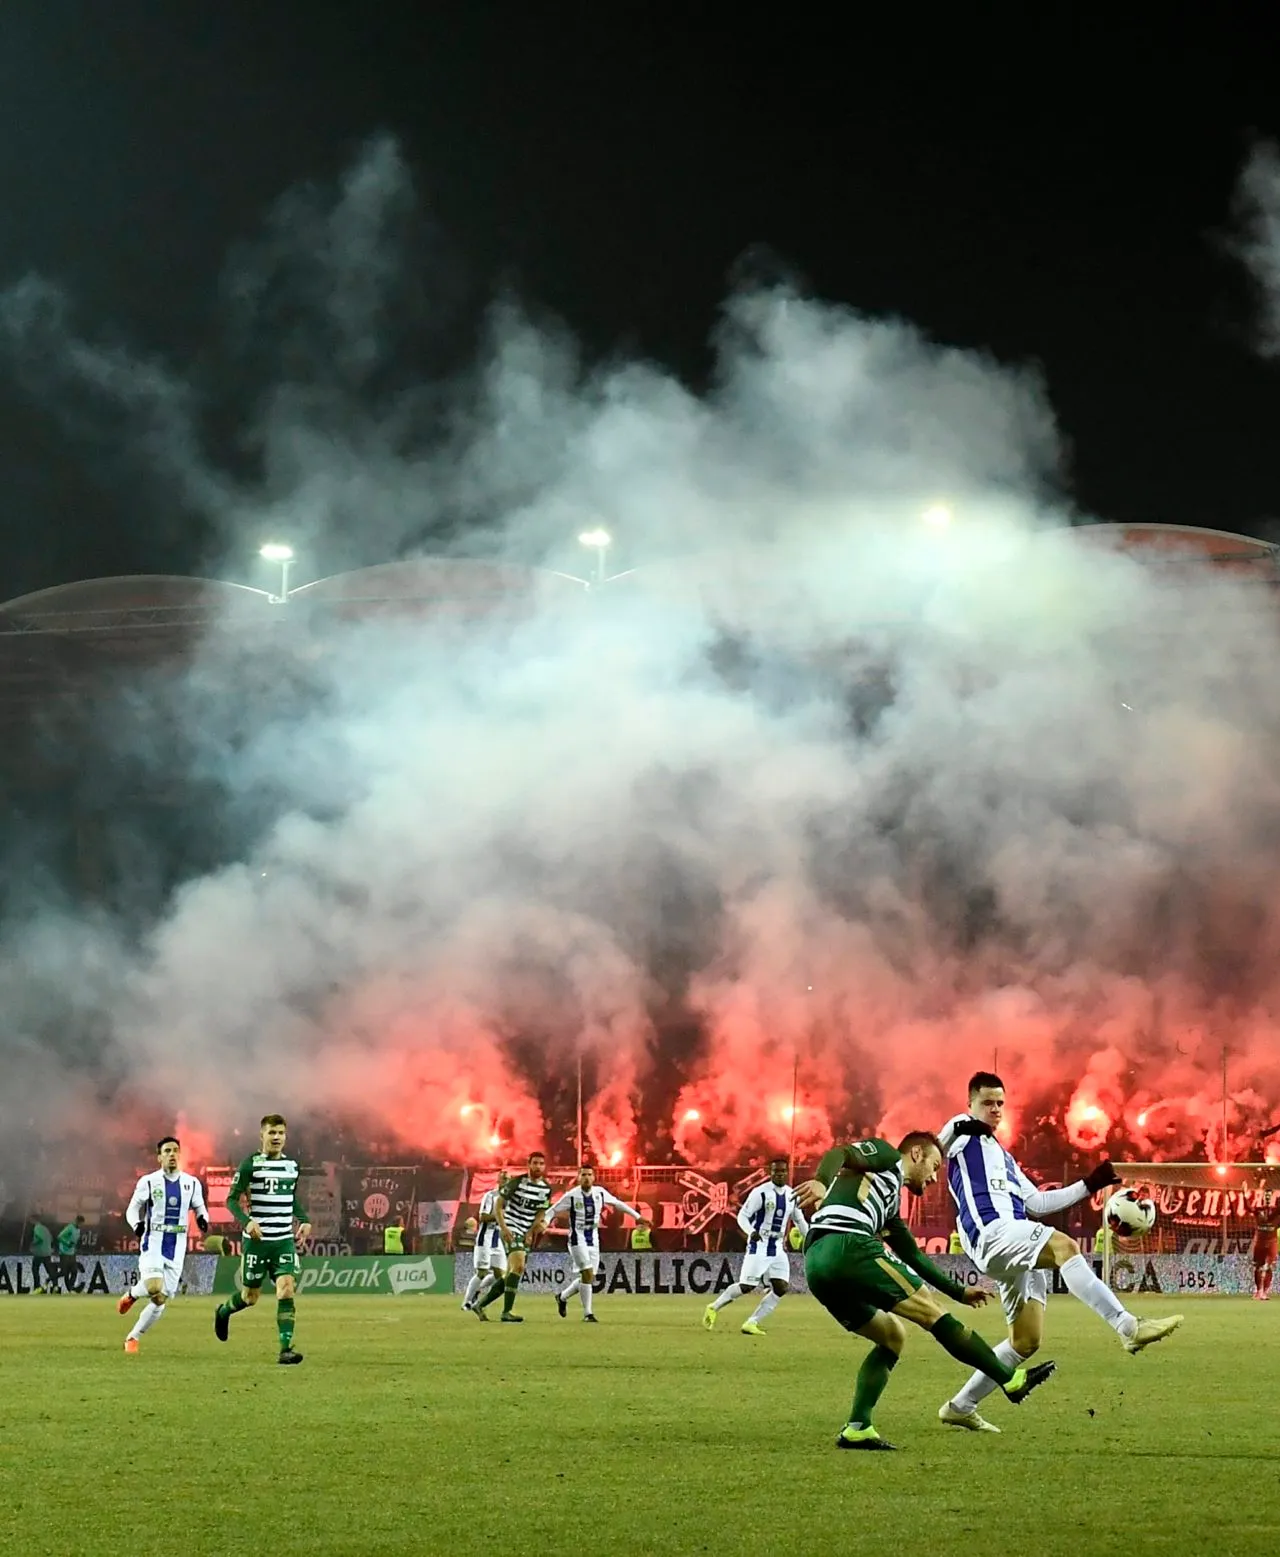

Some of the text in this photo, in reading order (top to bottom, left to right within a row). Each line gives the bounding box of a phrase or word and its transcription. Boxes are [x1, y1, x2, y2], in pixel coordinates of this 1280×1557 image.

[298, 1261, 385, 1294] pbank
[396, 1270, 429, 1282] LIGA
[520, 1269, 565, 1284] ANNO
[591, 1258, 735, 1294] GALLICA
[1178, 1271, 1216, 1288] 1852
